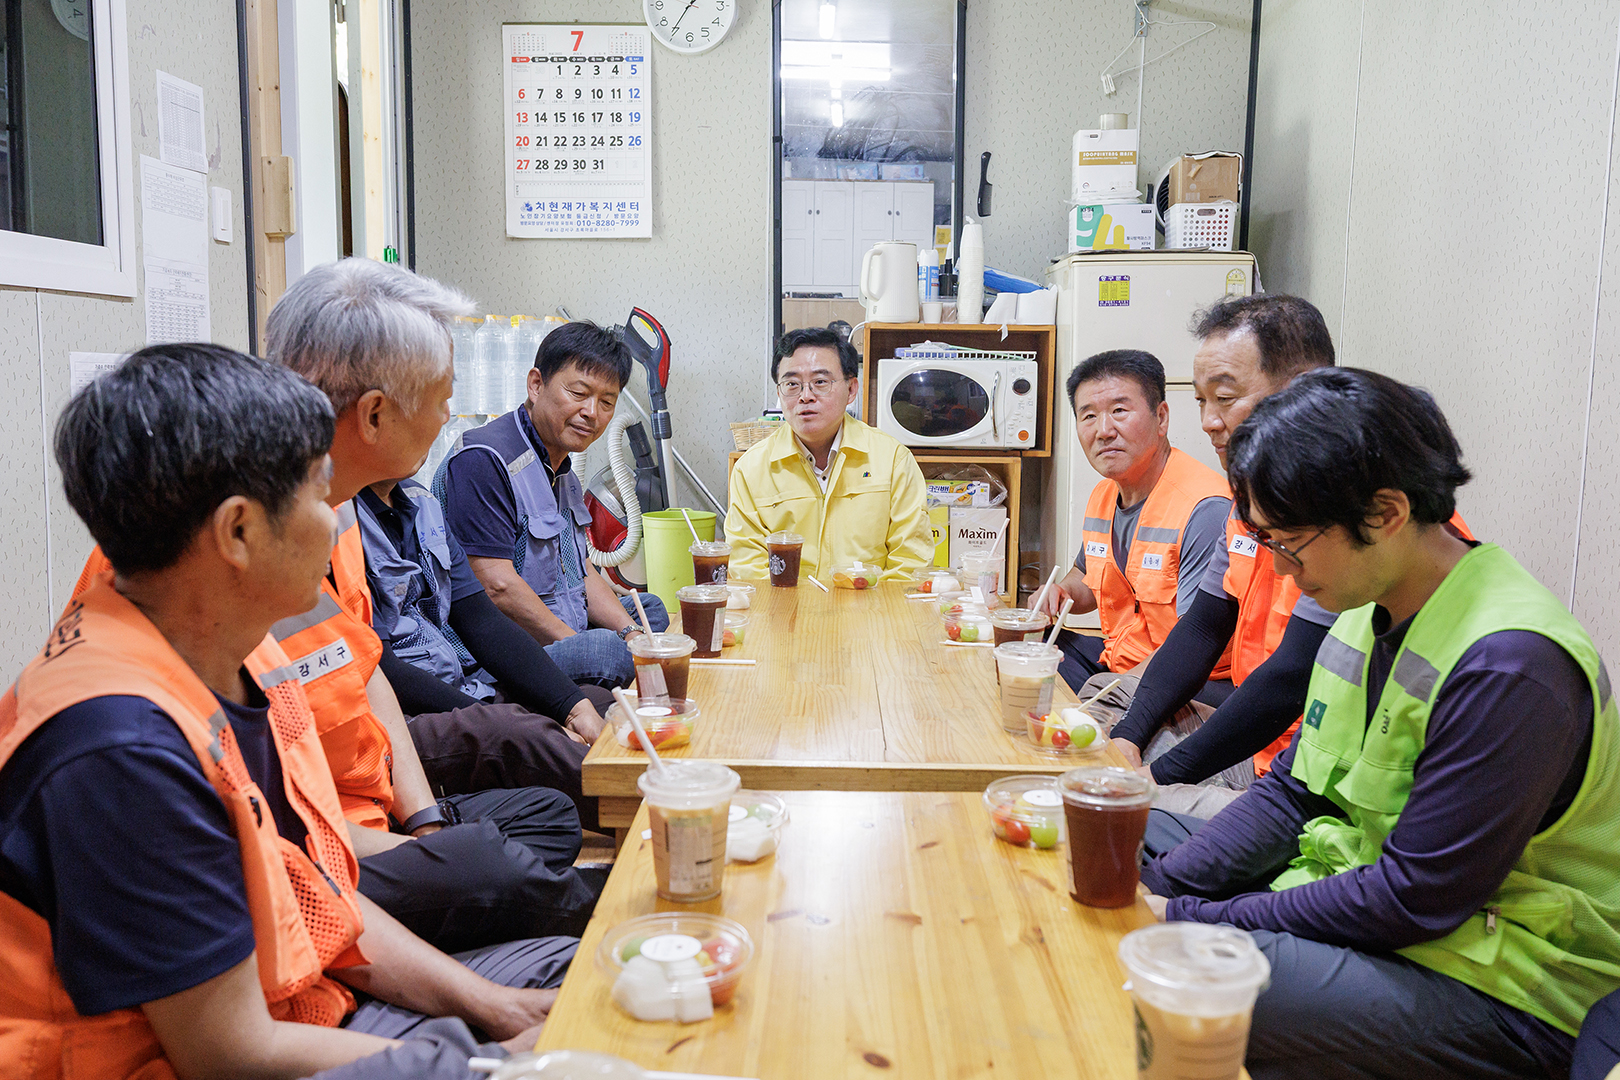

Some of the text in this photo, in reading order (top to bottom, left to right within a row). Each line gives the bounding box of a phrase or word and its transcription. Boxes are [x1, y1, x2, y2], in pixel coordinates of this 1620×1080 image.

[655, 0, 725, 11] 9 3
[659, 16, 720, 27] 8 4
[671, 26, 710, 38] 7 5
[685, 32, 694, 43] 6
[570, 30, 584, 52] 7
[557, 65, 562, 75] 1
[574, 65, 581, 75] 2
[593, 65, 600, 75] 3
[611, 65, 619, 75] 4
[630, 64, 637, 75] 5
[518, 87, 640, 99] 6 7 8 9 10 11 12
[516, 111, 641, 123] 13 14 15 16 17 18 19
[515, 135, 642, 147] 20 21 22 23 24 25 26
[516, 159, 530, 170] 27
[535, 159, 549, 170] 28
[554, 159, 568, 170] 29
[572, 159, 586, 170] 30
[592, 159, 604, 170] 31
[535, 201, 640, 212] 치현재가복지센터
[576, 219, 640, 227] 010-8280-7999
[958, 528, 997, 539] Maxim
[298, 646, 346, 678] 강서구
